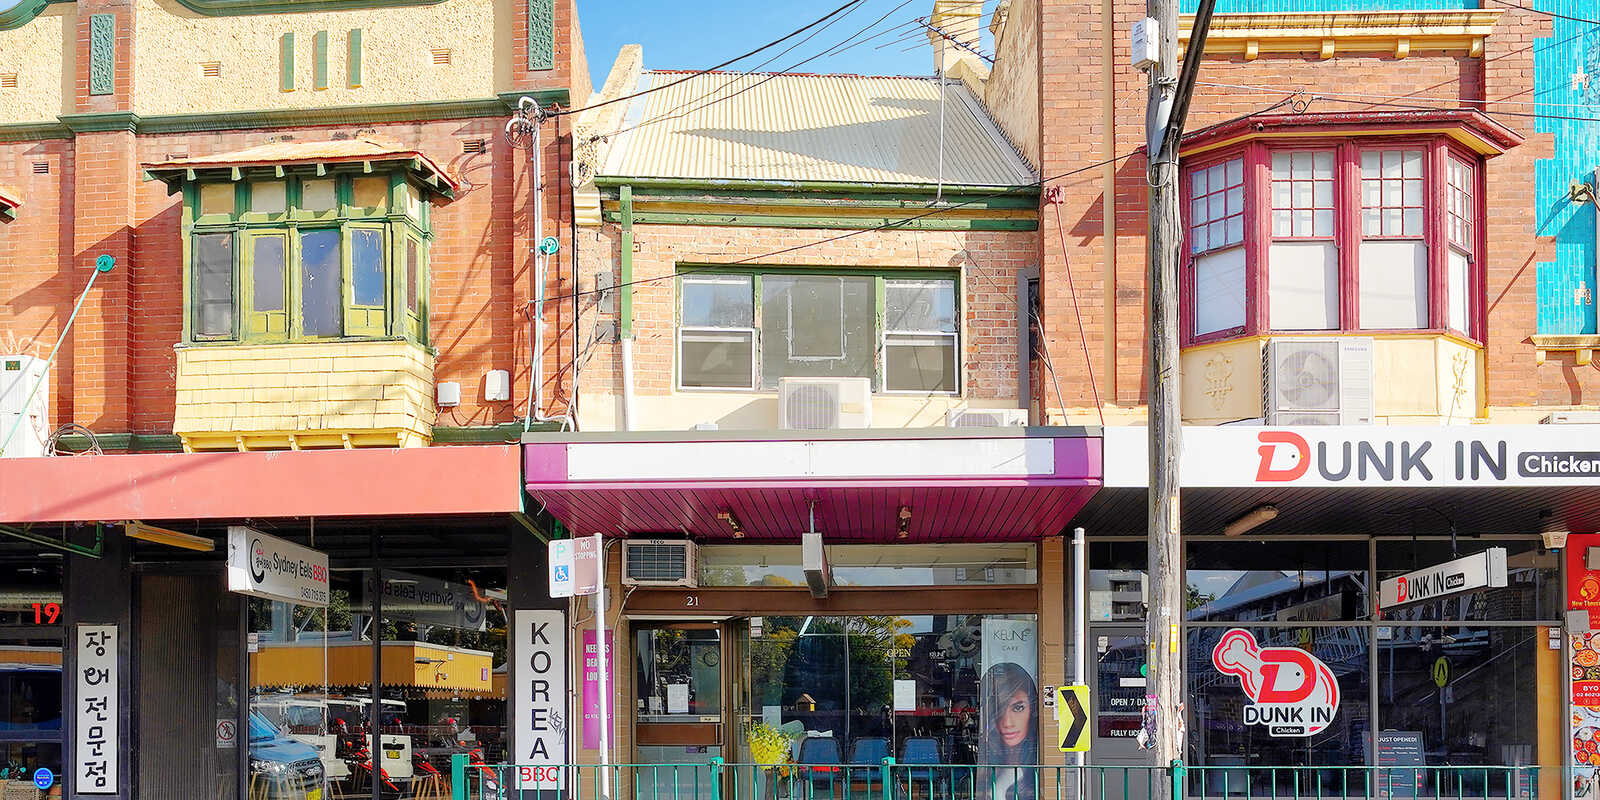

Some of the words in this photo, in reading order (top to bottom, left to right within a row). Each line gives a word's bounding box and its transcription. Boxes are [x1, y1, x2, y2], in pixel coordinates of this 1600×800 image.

[1256, 431, 1433, 482] DUNK
[1455, 441, 1506, 481] IN
[1525, 455, 1600, 474] Chicken
[273, 552, 299, 579] Sydney
[300, 560, 312, 579] Eels
[312, 564, 327, 584] BBQ
[1397, 576, 1430, 603] DUNK
[1433, 571, 1444, 594] IN
[687, 597, 699, 606] 21
[32, 603, 60, 624] 19
[887, 649, 911, 657] OPEN
[529, 622, 551, 759] KOREA
[1111, 698, 1128, 706] OPEN
[1130, 698, 1135, 706] 7
[1137, 698, 1146, 706] DA
[1246, 706, 1303, 723] DUNK
[1311, 706, 1331, 723] IN
[520, 767, 558, 782] BBQ
